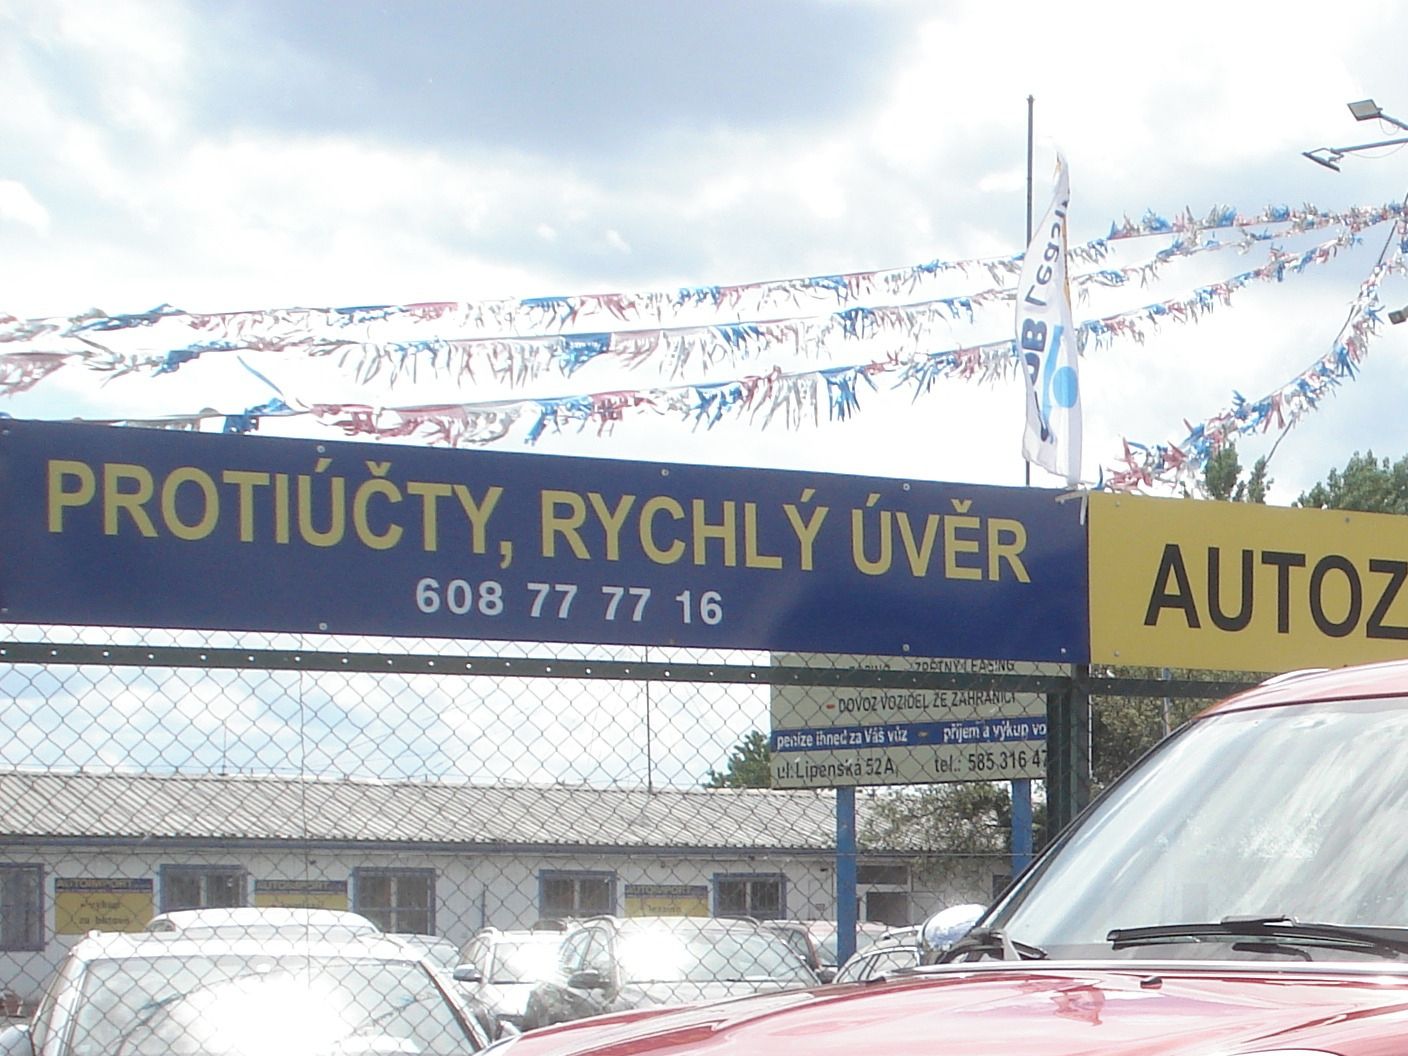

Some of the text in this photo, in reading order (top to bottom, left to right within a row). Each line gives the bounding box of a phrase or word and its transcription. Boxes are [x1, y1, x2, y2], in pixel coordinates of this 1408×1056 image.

[48, 457, 1032, 584] PROTIÚČTY, RYCHLÝ ÚVĚR
[416, 577, 722, 625] 608 77 77 16
[838, 696, 877, 713] DOVOZ
[880, 694, 927, 712] VOZIDEL
[777, 731, 813, 750] peníze
[816, 730, 847, 746] ihned
[849, 733, 862, 745] za
[864, 727, 884, 743] Váš
[887, 726, 907, 743] vůz
[992, 721, 1029, 741] výkup
[795, 757, 862, 782] Lipenská
[968, 752, 994, 771] 585
[1000, 751, 1026, 770] 316
